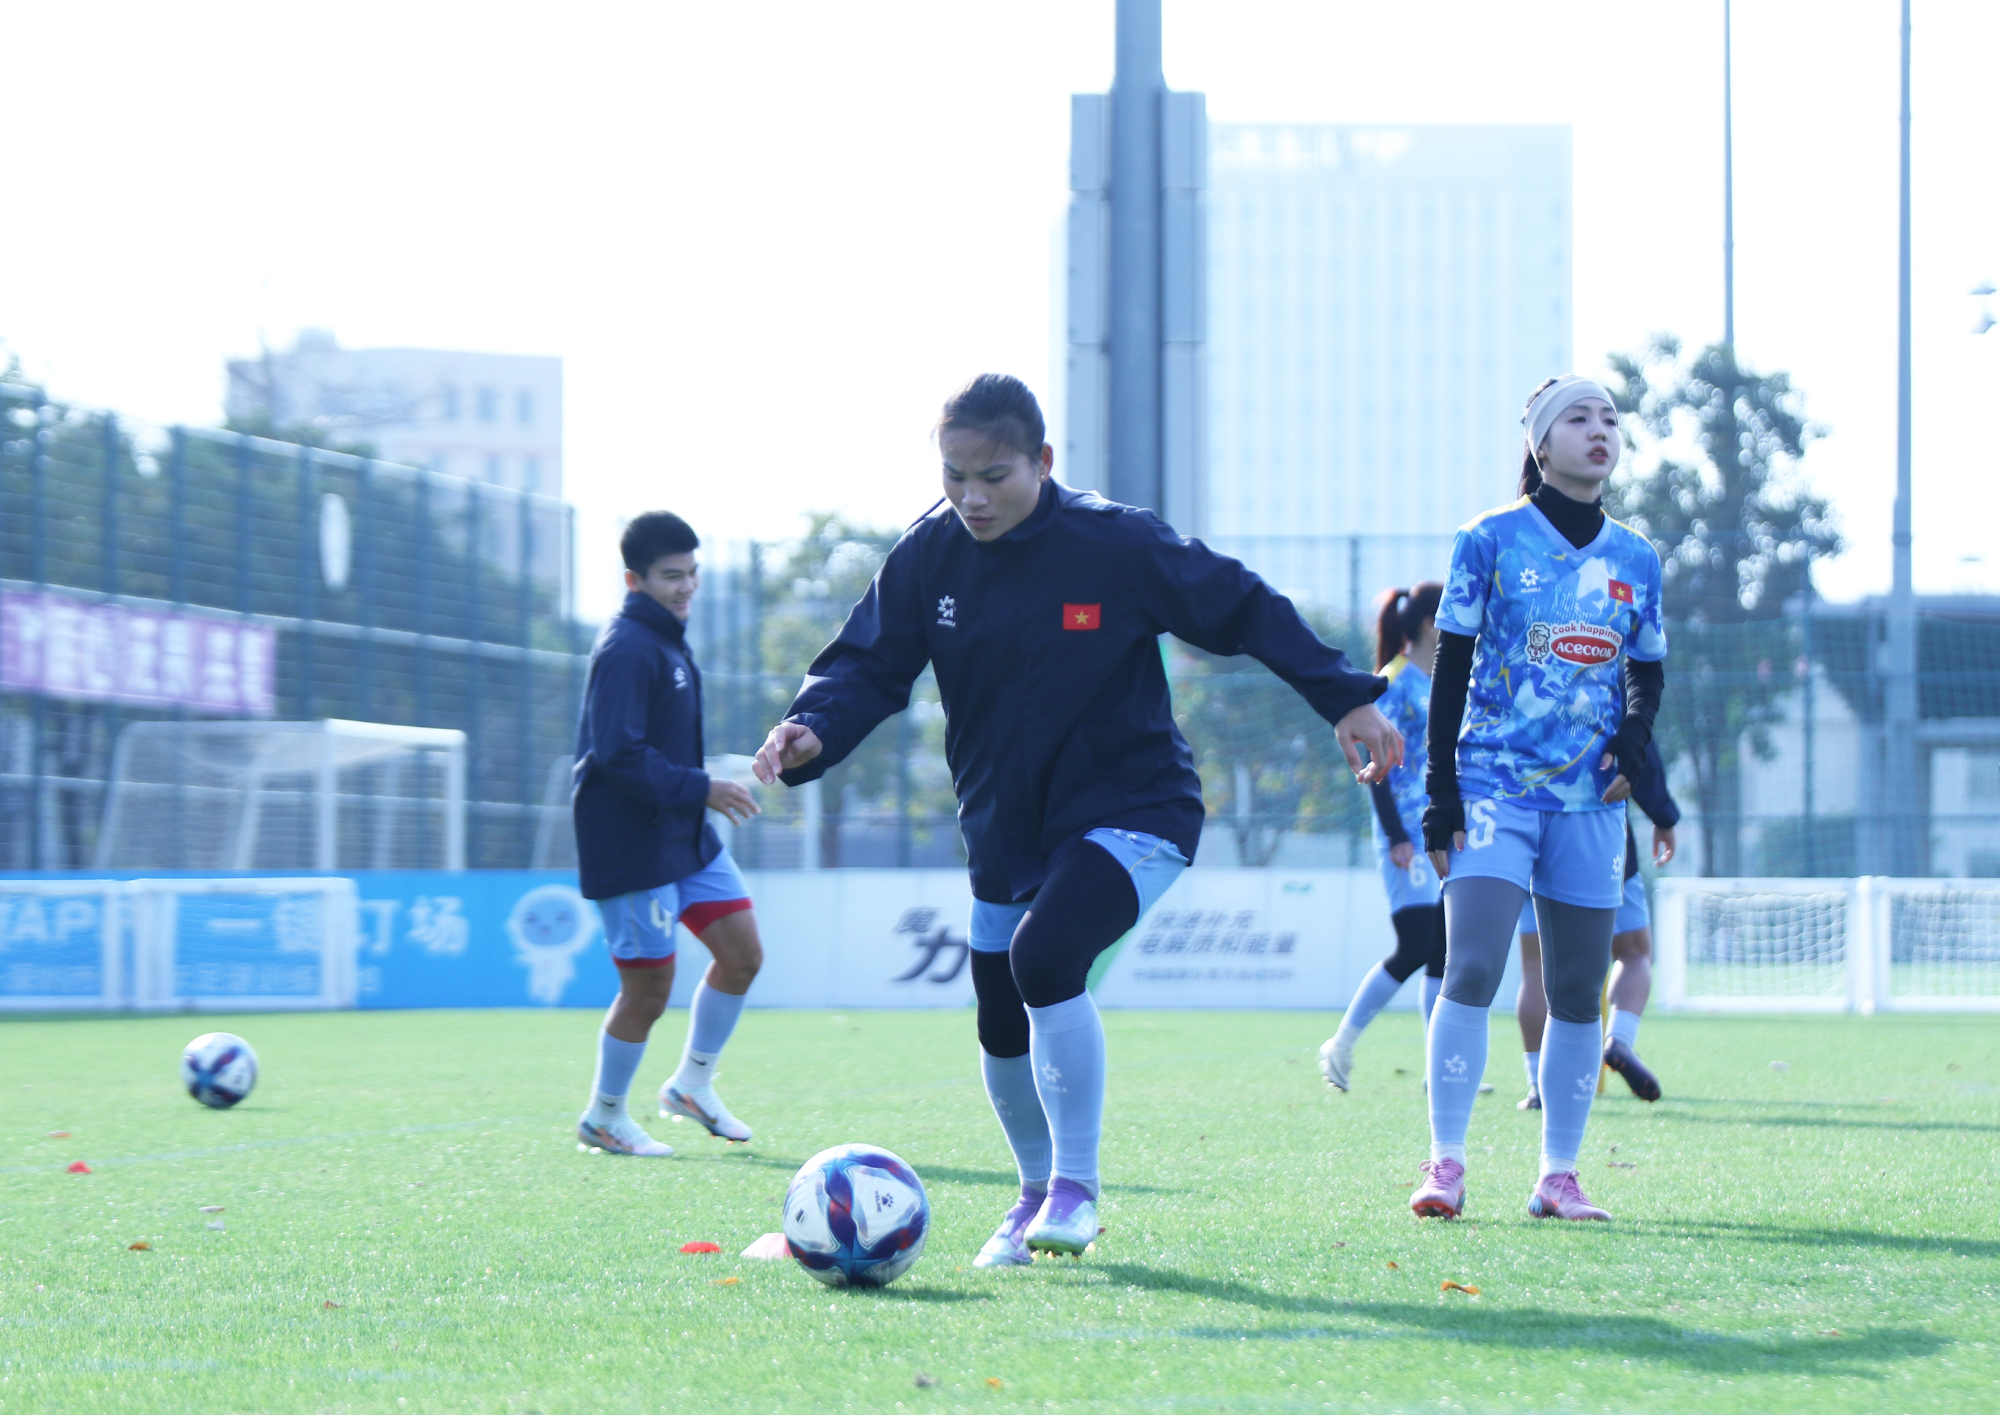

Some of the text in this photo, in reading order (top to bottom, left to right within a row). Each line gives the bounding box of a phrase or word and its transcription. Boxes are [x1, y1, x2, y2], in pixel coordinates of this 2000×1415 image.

[1552, 623, 1622, 644] Cook happiness
[1463, 799, 1497, 850] 5
